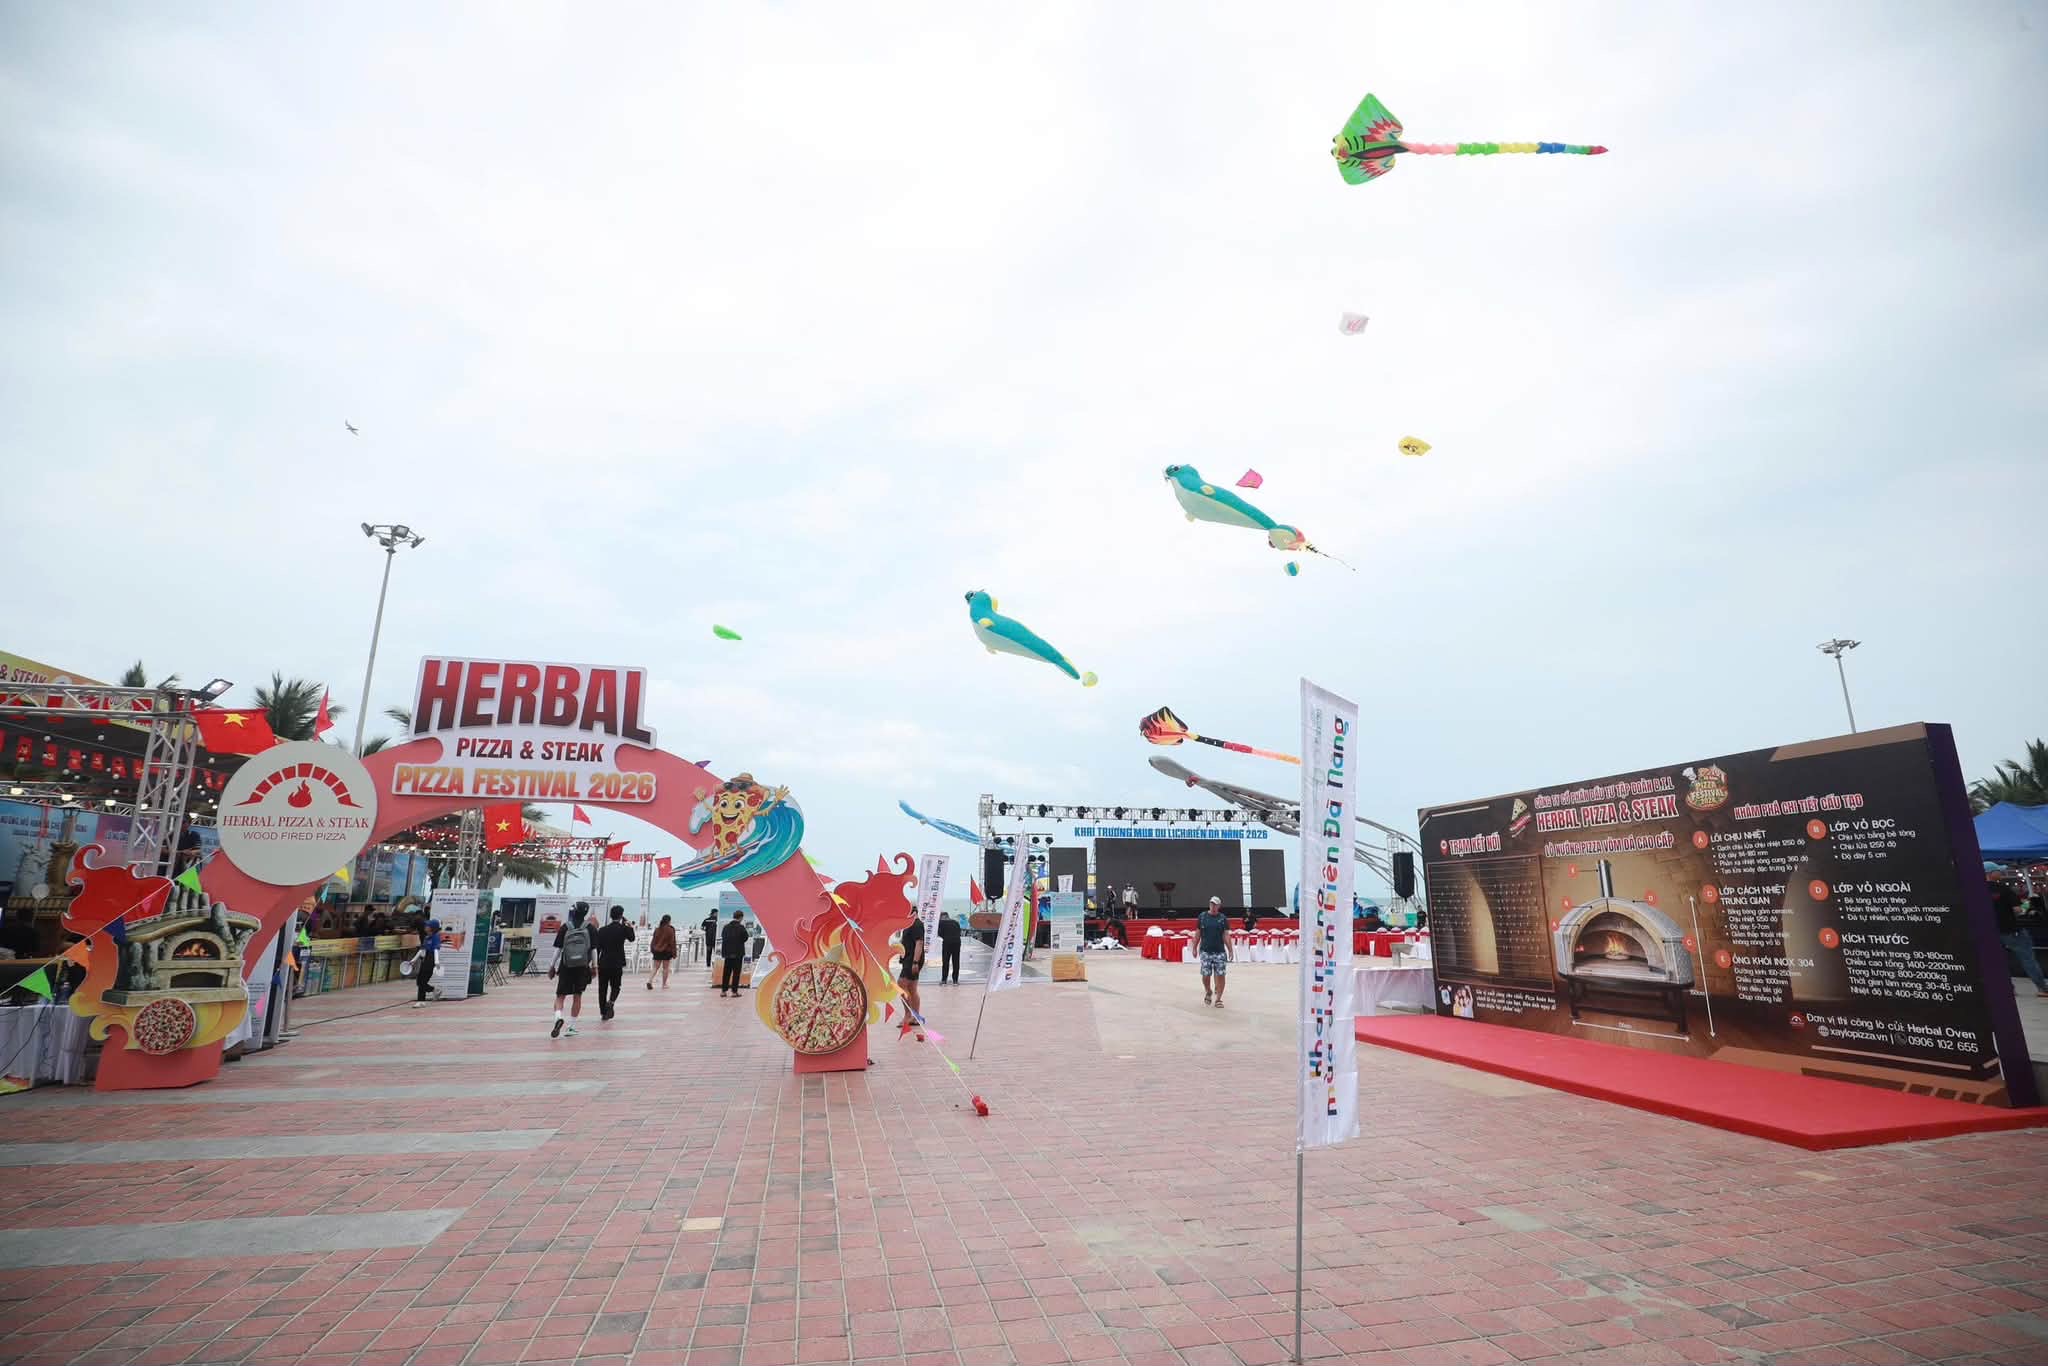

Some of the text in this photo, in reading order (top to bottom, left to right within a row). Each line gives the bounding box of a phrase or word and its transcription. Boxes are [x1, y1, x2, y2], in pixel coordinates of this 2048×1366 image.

[415, 660, 650, 744] HERBAL
[456, 738, 604, 762] PIZZA & STEAK
[395, 767, 654, 799] PIZZA FESTIVAL 2026
[1691, 789, 1724, 798] FESTIVAL
[1536, 794, 1679, 832] HERBAL PIZZA & STEAK
[223, 816, 369, 828] HERBAL PIZZA & STEAK
[243, 832, 278, 840] WOOD
[281, 832, 313, 840] FIRED
[1075, 827, 1095, 837] KHAI
[1246, 829, 1268, 839] 2026
[1580, 841, 1602, 855] PIZZA
[1636, 835, 1655, 849] CAO
[1833, 881, 1911, 893] LỚP VỎ NGOÀI
[1721, 897, 1770, 905] TRUNG GIAN
[1842, 932, 1909, 945] KÍCH THƯỚC
[1774, 957, 1795, 966] INOX
[1798, 958, 1814, 967] 304
[1913, 952, 1953, 960] 90-180cm
[1907, 961, 1965, 971] 1400-2200mm
[1898, 971, 1947, 982] 800-2000kg
[1926, 982, 1951, 990] 30-45
[1895, 990, 1929, 999] 400-500
[1946, 993, 1953, 1001] C
[1807, 1013, 1976, 1040] Đơn vị thi công lò Herbal Oven
[1830, 1028, 1978, 1053] xaylopizza.vn 0906 102 655
